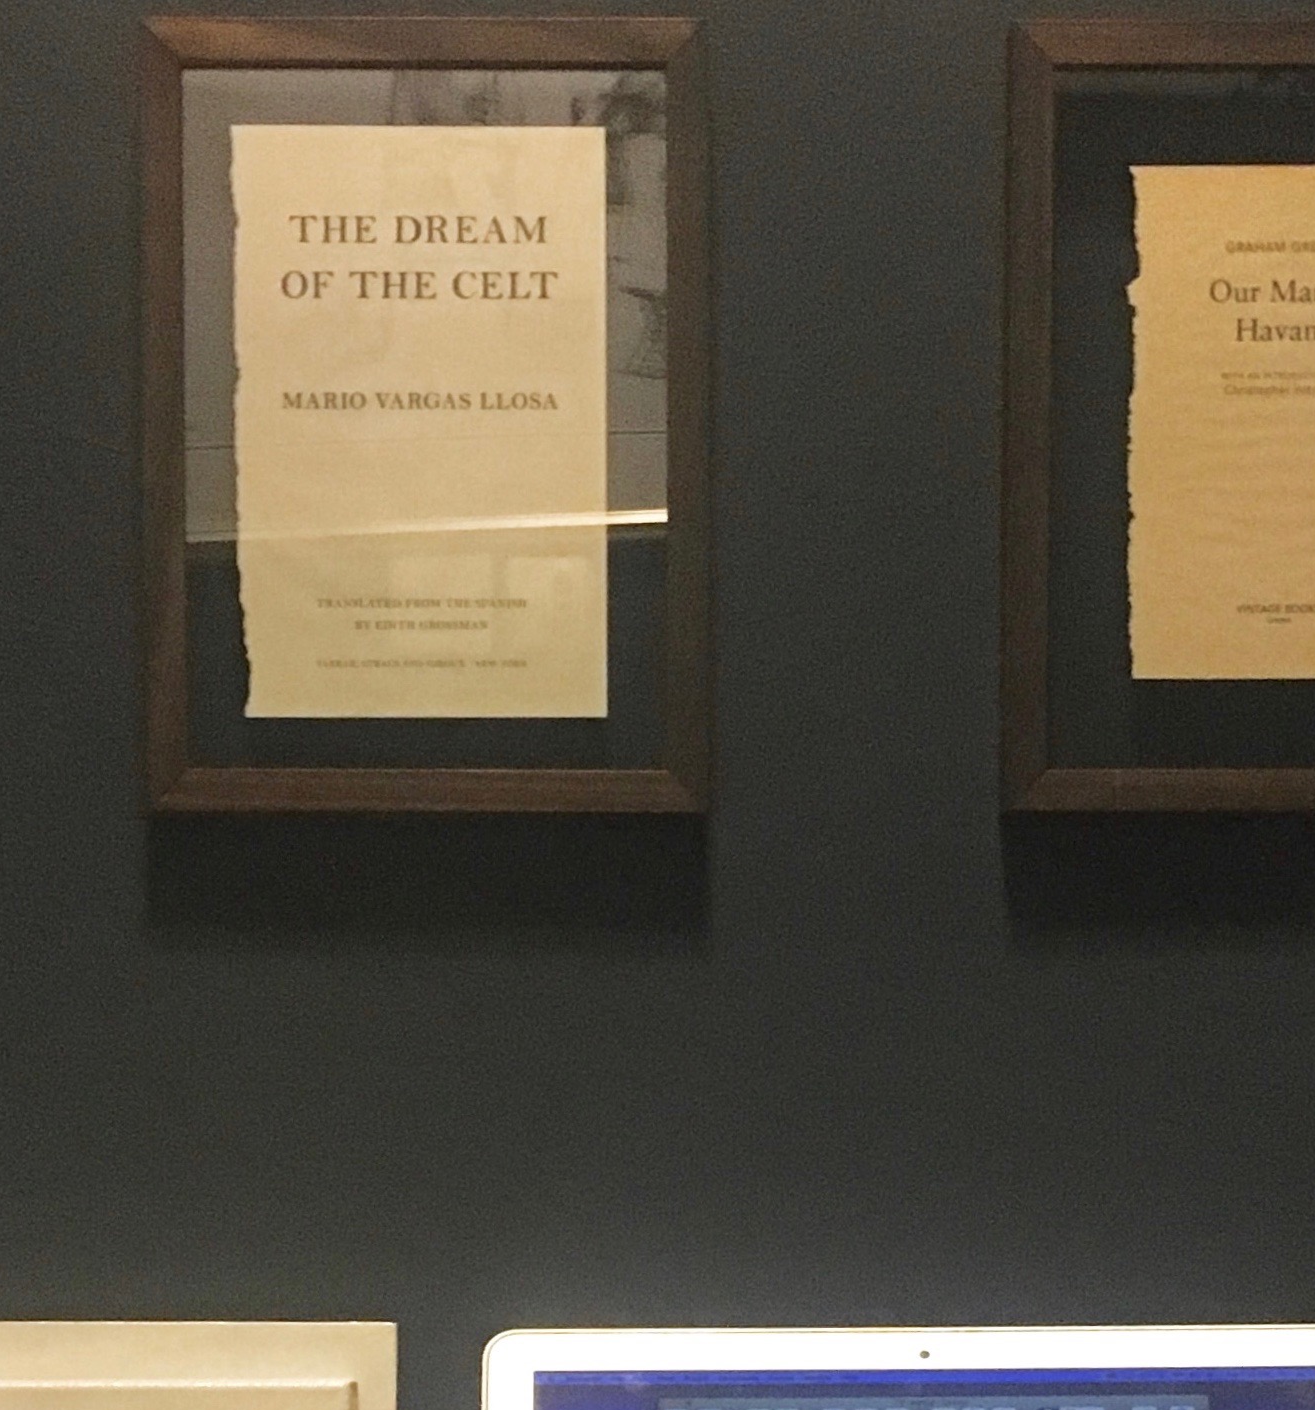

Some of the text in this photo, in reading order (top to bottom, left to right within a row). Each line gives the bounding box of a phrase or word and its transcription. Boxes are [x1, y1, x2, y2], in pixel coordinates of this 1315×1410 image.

[289, 214, 547, 244] THE DREAM
[281, 270, 559, 300] OF THE CELT
[1209, 279, 1262, 303] Our
[282, 392, 559, 411] MARIO VARGAS LLOSA
